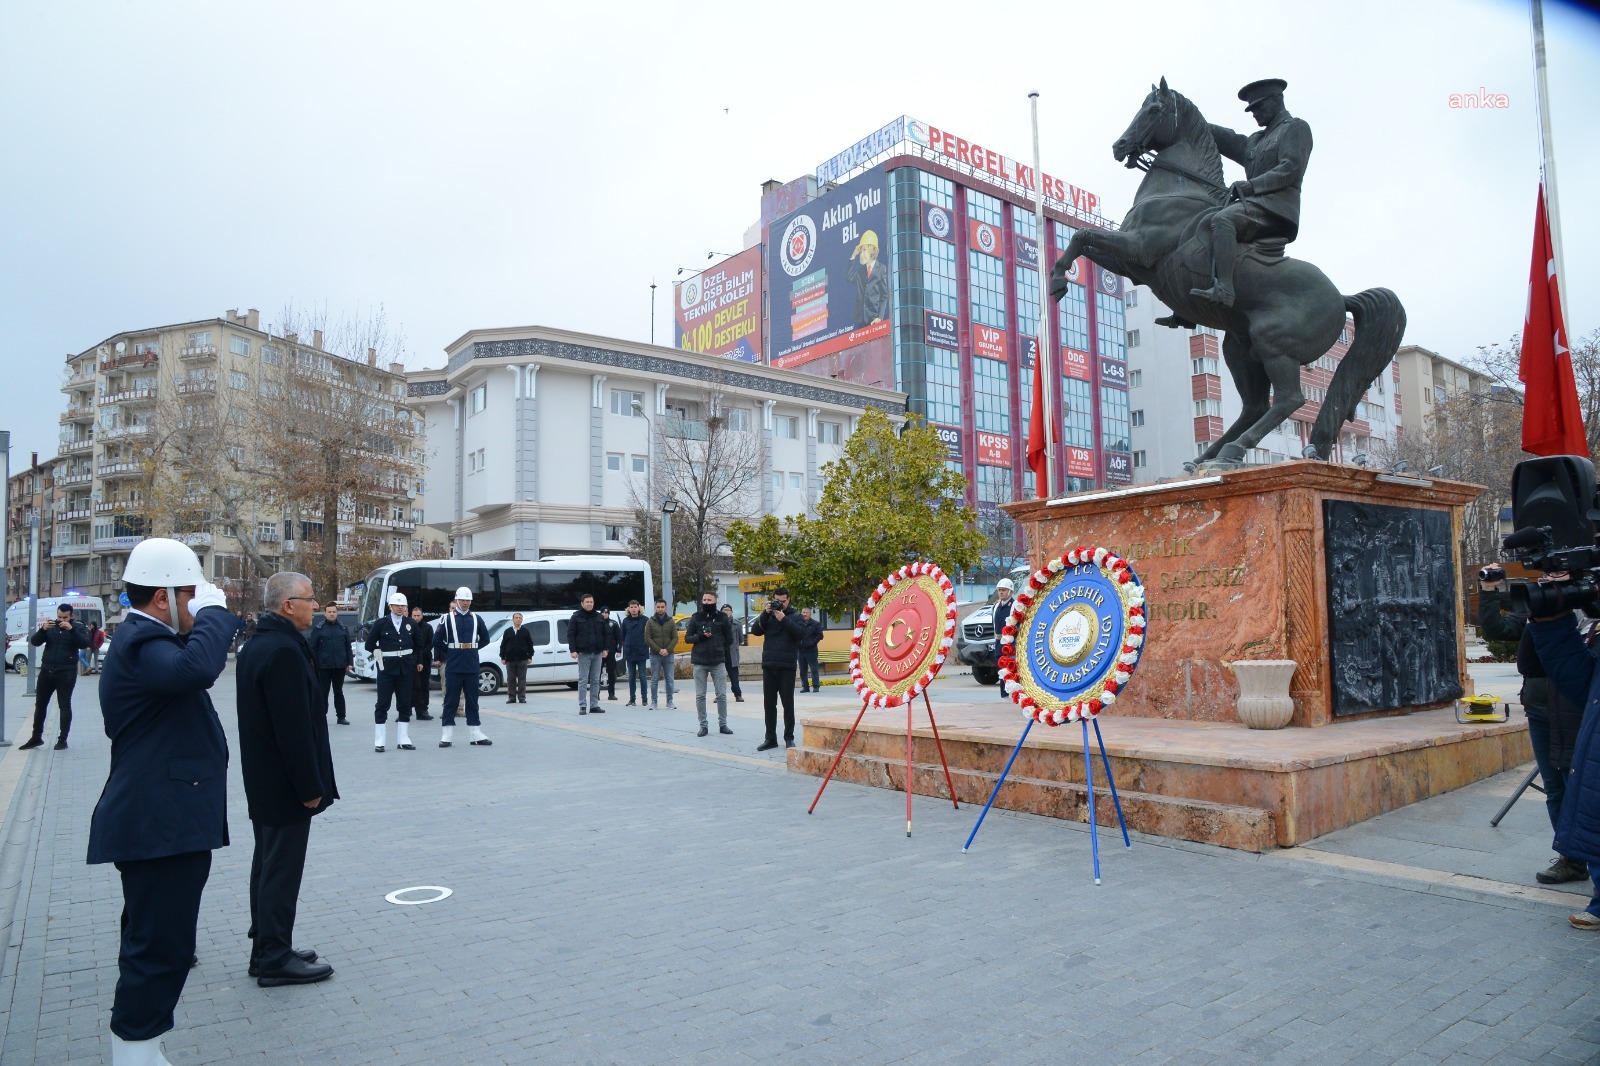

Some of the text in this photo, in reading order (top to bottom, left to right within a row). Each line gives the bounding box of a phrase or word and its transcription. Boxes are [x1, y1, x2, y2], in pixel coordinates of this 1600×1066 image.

[928, 126, 1010, 179] PERGEL
[822, 188, 880, 231] Aklın Yolu
[842, 220, 859, 244] BİL
[704, 270, 728, 290] ÖZEL
[704, 268, 754, 302] OSB BİLİM
[684, 280, 754, 322] TEKNİK KOLEJİ
[682, 320, 712, 353] %100
[715, 298, 748, 328] DEVLET
[715, 312, 756, 349] DESTEKLİ
[930, 316, 954, 332] TUS
[978, 342, 1002, 352] GRUPLAR
[1068, 350, 1084, 364] ÖDG
[980, 434, 1008, 450] KPSS
[989, 450, 1001, 458] A-B
[1072, 448, 1088, 461] YDS
[1110, 457, 1127, 470] AÖF
[1160, 567, 1245, 592] ŞARTSIZ
[902, 594, 918, 605] T.C.
[1049, 585, 1104, 613] KIRŞEHİR
[871, 626, 892, 676] KIRŞEHİR
[1034, 614, 1112, 684] BELEDİYE BAŞKANLIĞI
